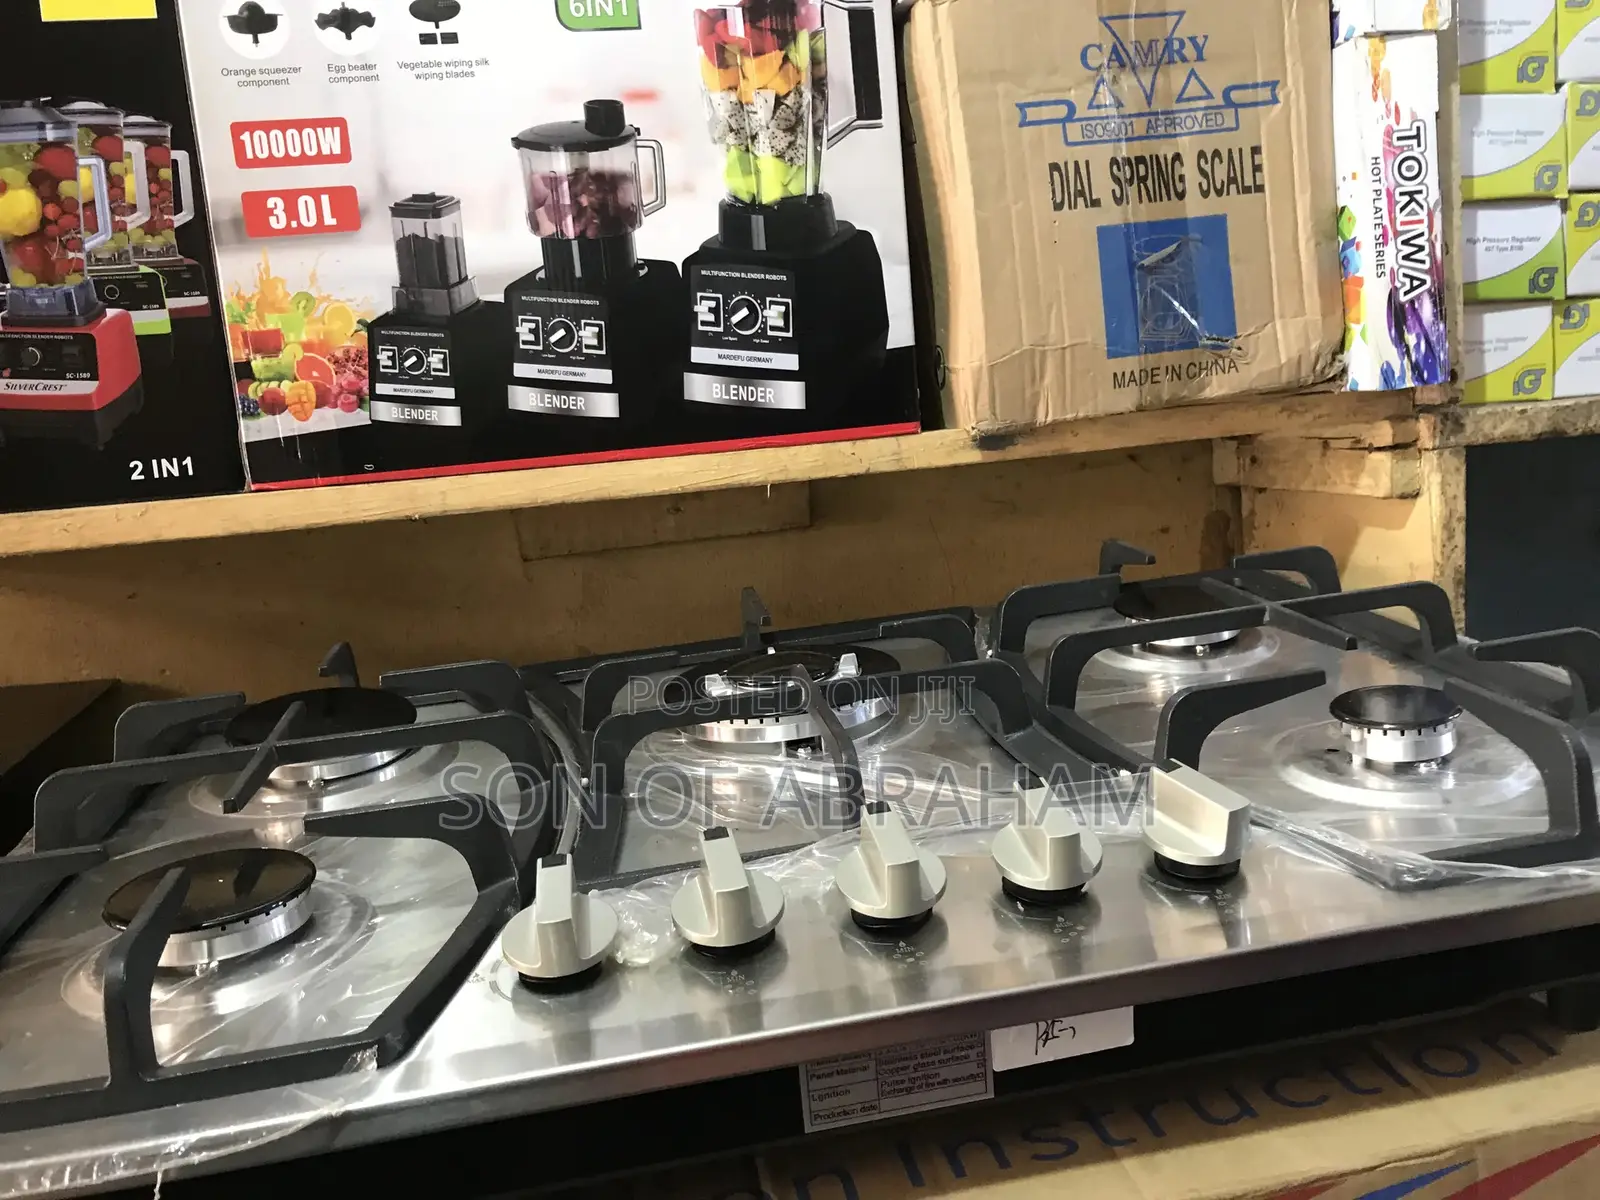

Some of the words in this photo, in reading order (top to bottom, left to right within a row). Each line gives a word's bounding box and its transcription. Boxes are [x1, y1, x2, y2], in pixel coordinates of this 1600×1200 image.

[1079, 35, 1209, 73] CAMRY
[220, 67, 256, 77] Orange
[258, 65, 302, 75] squeezer
[327, 63, 346, 74] Egg
[347, 62, 377, 72] beater
[397, 59, 442, 71] Vegetable
[444, 59, 473, 69] wiping
[475, 58, 490, 66] silk
[237, 77, 290, 88] component
[328, 74, 380, 84] component
[414, 71, 443, 81] wiping
[445, 69, 475, 79] blades
[1145, 112, 1225, 135] APPROVED
[239, 127, 341, 159] 10000W
[1048, 159, 1102, 212] DIAL
[1109, 151, 1187, 207] SPRING
[1196, 146, 1265, 199] SCALE
[1371, 156, 1381, 184] HOT
[266, 194, 337, 230] 3.0L
[1372, 188, 1384, 232] PLATE
[1396, 125, 1429, 298] TOKIWA
[1374, 234, 1386, 279] SERIES
[741, 272, 765, 280] BLENDER
[718, 354, 745, 362] MARDEFU
[746, 356, 773, 364] GERMANY
[1113, 367, 1161, 389] MADE
[1166, 364, 1182, 382] IN
[1186, 359, 1239, 380] CHINA
[528, 392, 585, 411] BLENDER
[712, 383, 775, 403] BLENDER
[391, 407, 438, 421] BLENDER
[129, 460, 145, 480] 2
[859, 1105, 878, 1114] date
